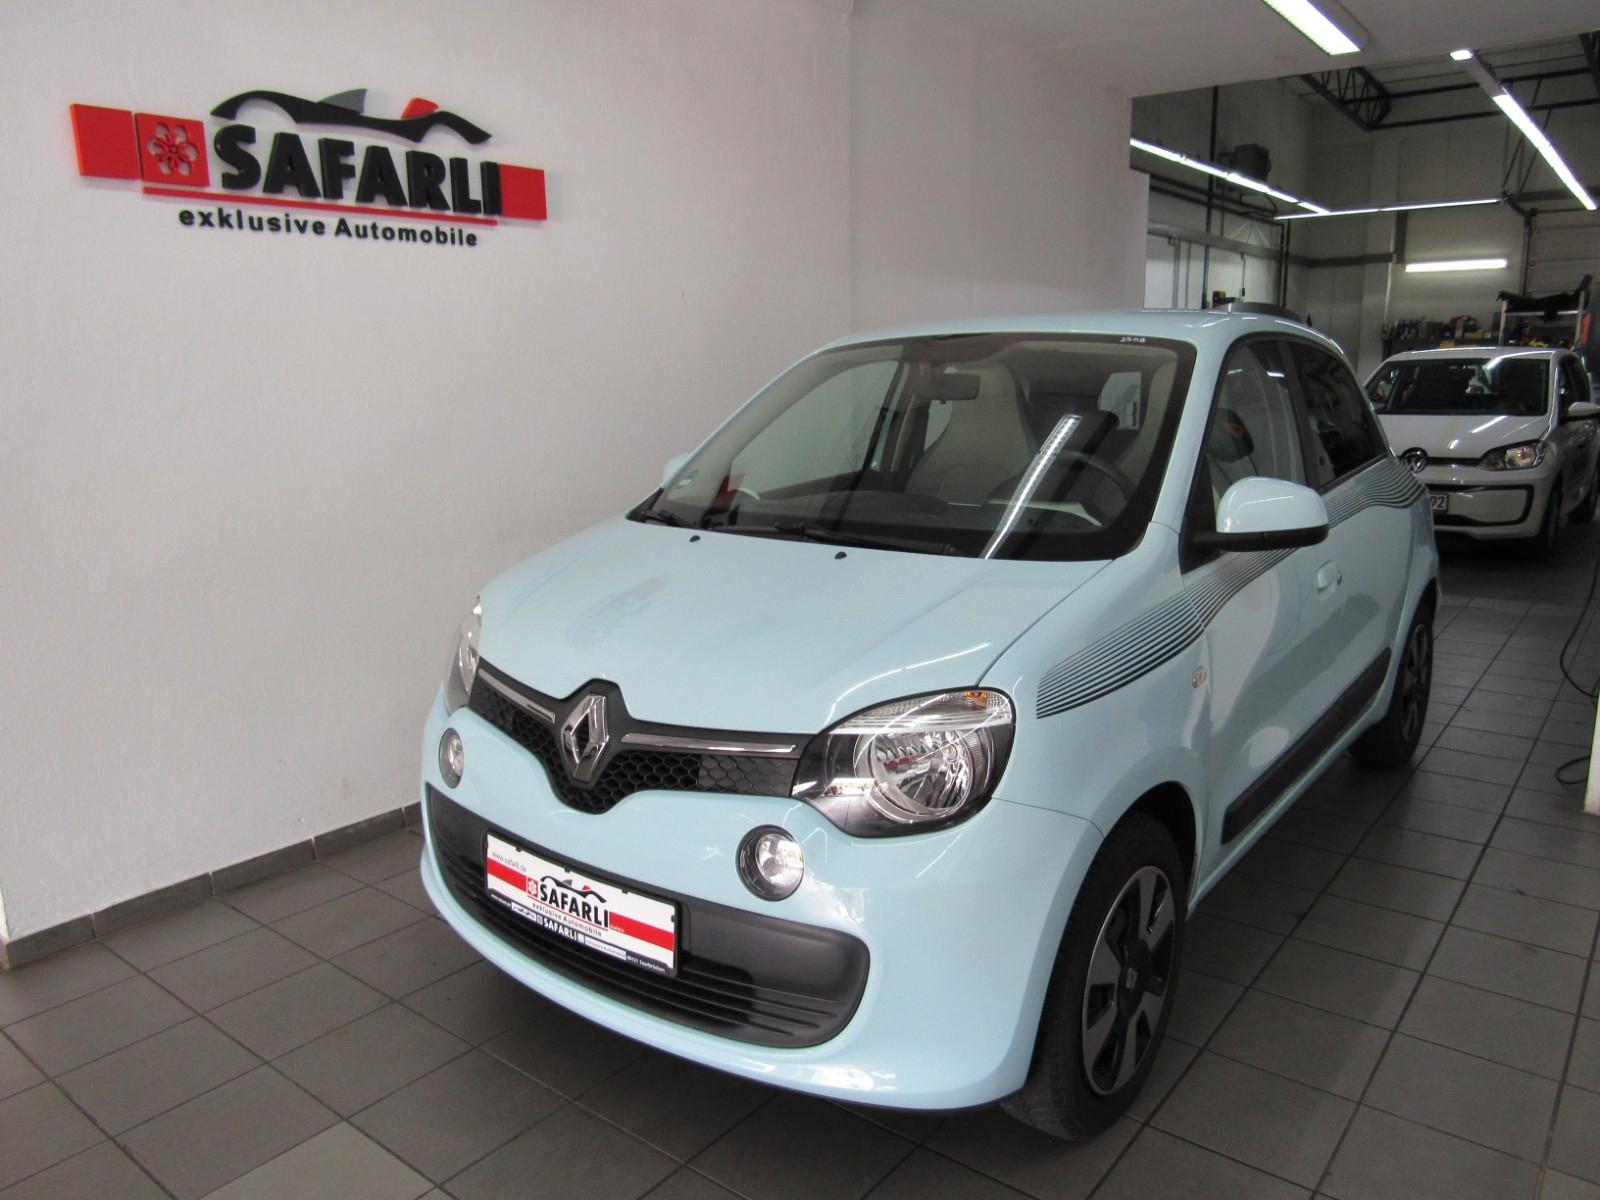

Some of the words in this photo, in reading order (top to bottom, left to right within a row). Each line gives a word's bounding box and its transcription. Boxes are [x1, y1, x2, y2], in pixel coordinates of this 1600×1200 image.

[213, 124, 501, 216] SAFARLI
[178, 206, 326, 236] exklusive
[334, 217, 478, 247] Automobile
[532, 902, 563, 920] exklusive
[563, 915, 602, 937] Automobile
[540, 884, 609, 929] SAFARLI
[543, 916, 578, 942] SAFARLI
